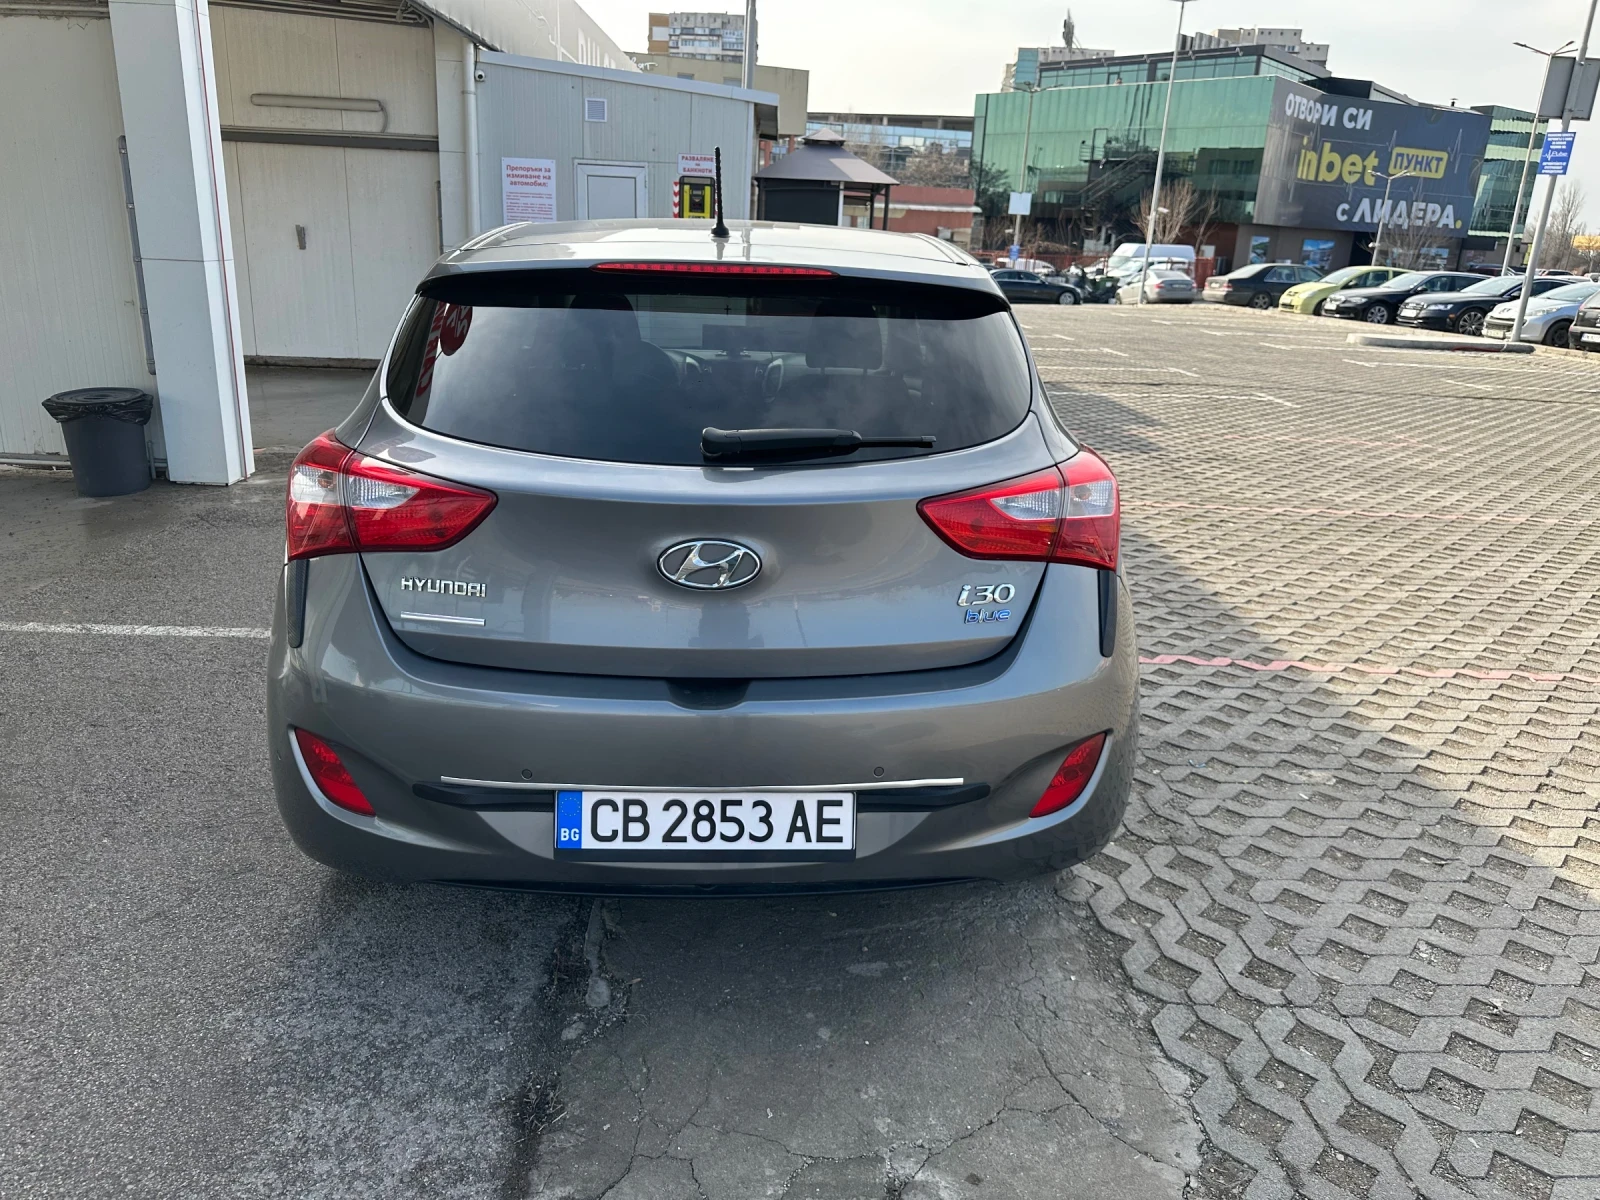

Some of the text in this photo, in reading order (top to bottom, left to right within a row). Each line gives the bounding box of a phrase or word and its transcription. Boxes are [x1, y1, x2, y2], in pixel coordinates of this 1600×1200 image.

[1285, 92, 1373, 130] ОТВОРИ СИ
[506, 164, 543, 173] Препоръки
[1297, 136, 1379, 186] inbet
[1394, 152, 1444, 175] ПУНКТ
[401, 577, 486, 598] HYUNDAI
[957, 583, 1016, 607] i30
[964, 608, 1011, 624] blue
[590, 798, 844, 843] CB 2853 AE
[560, 828, 580, 841] BG
